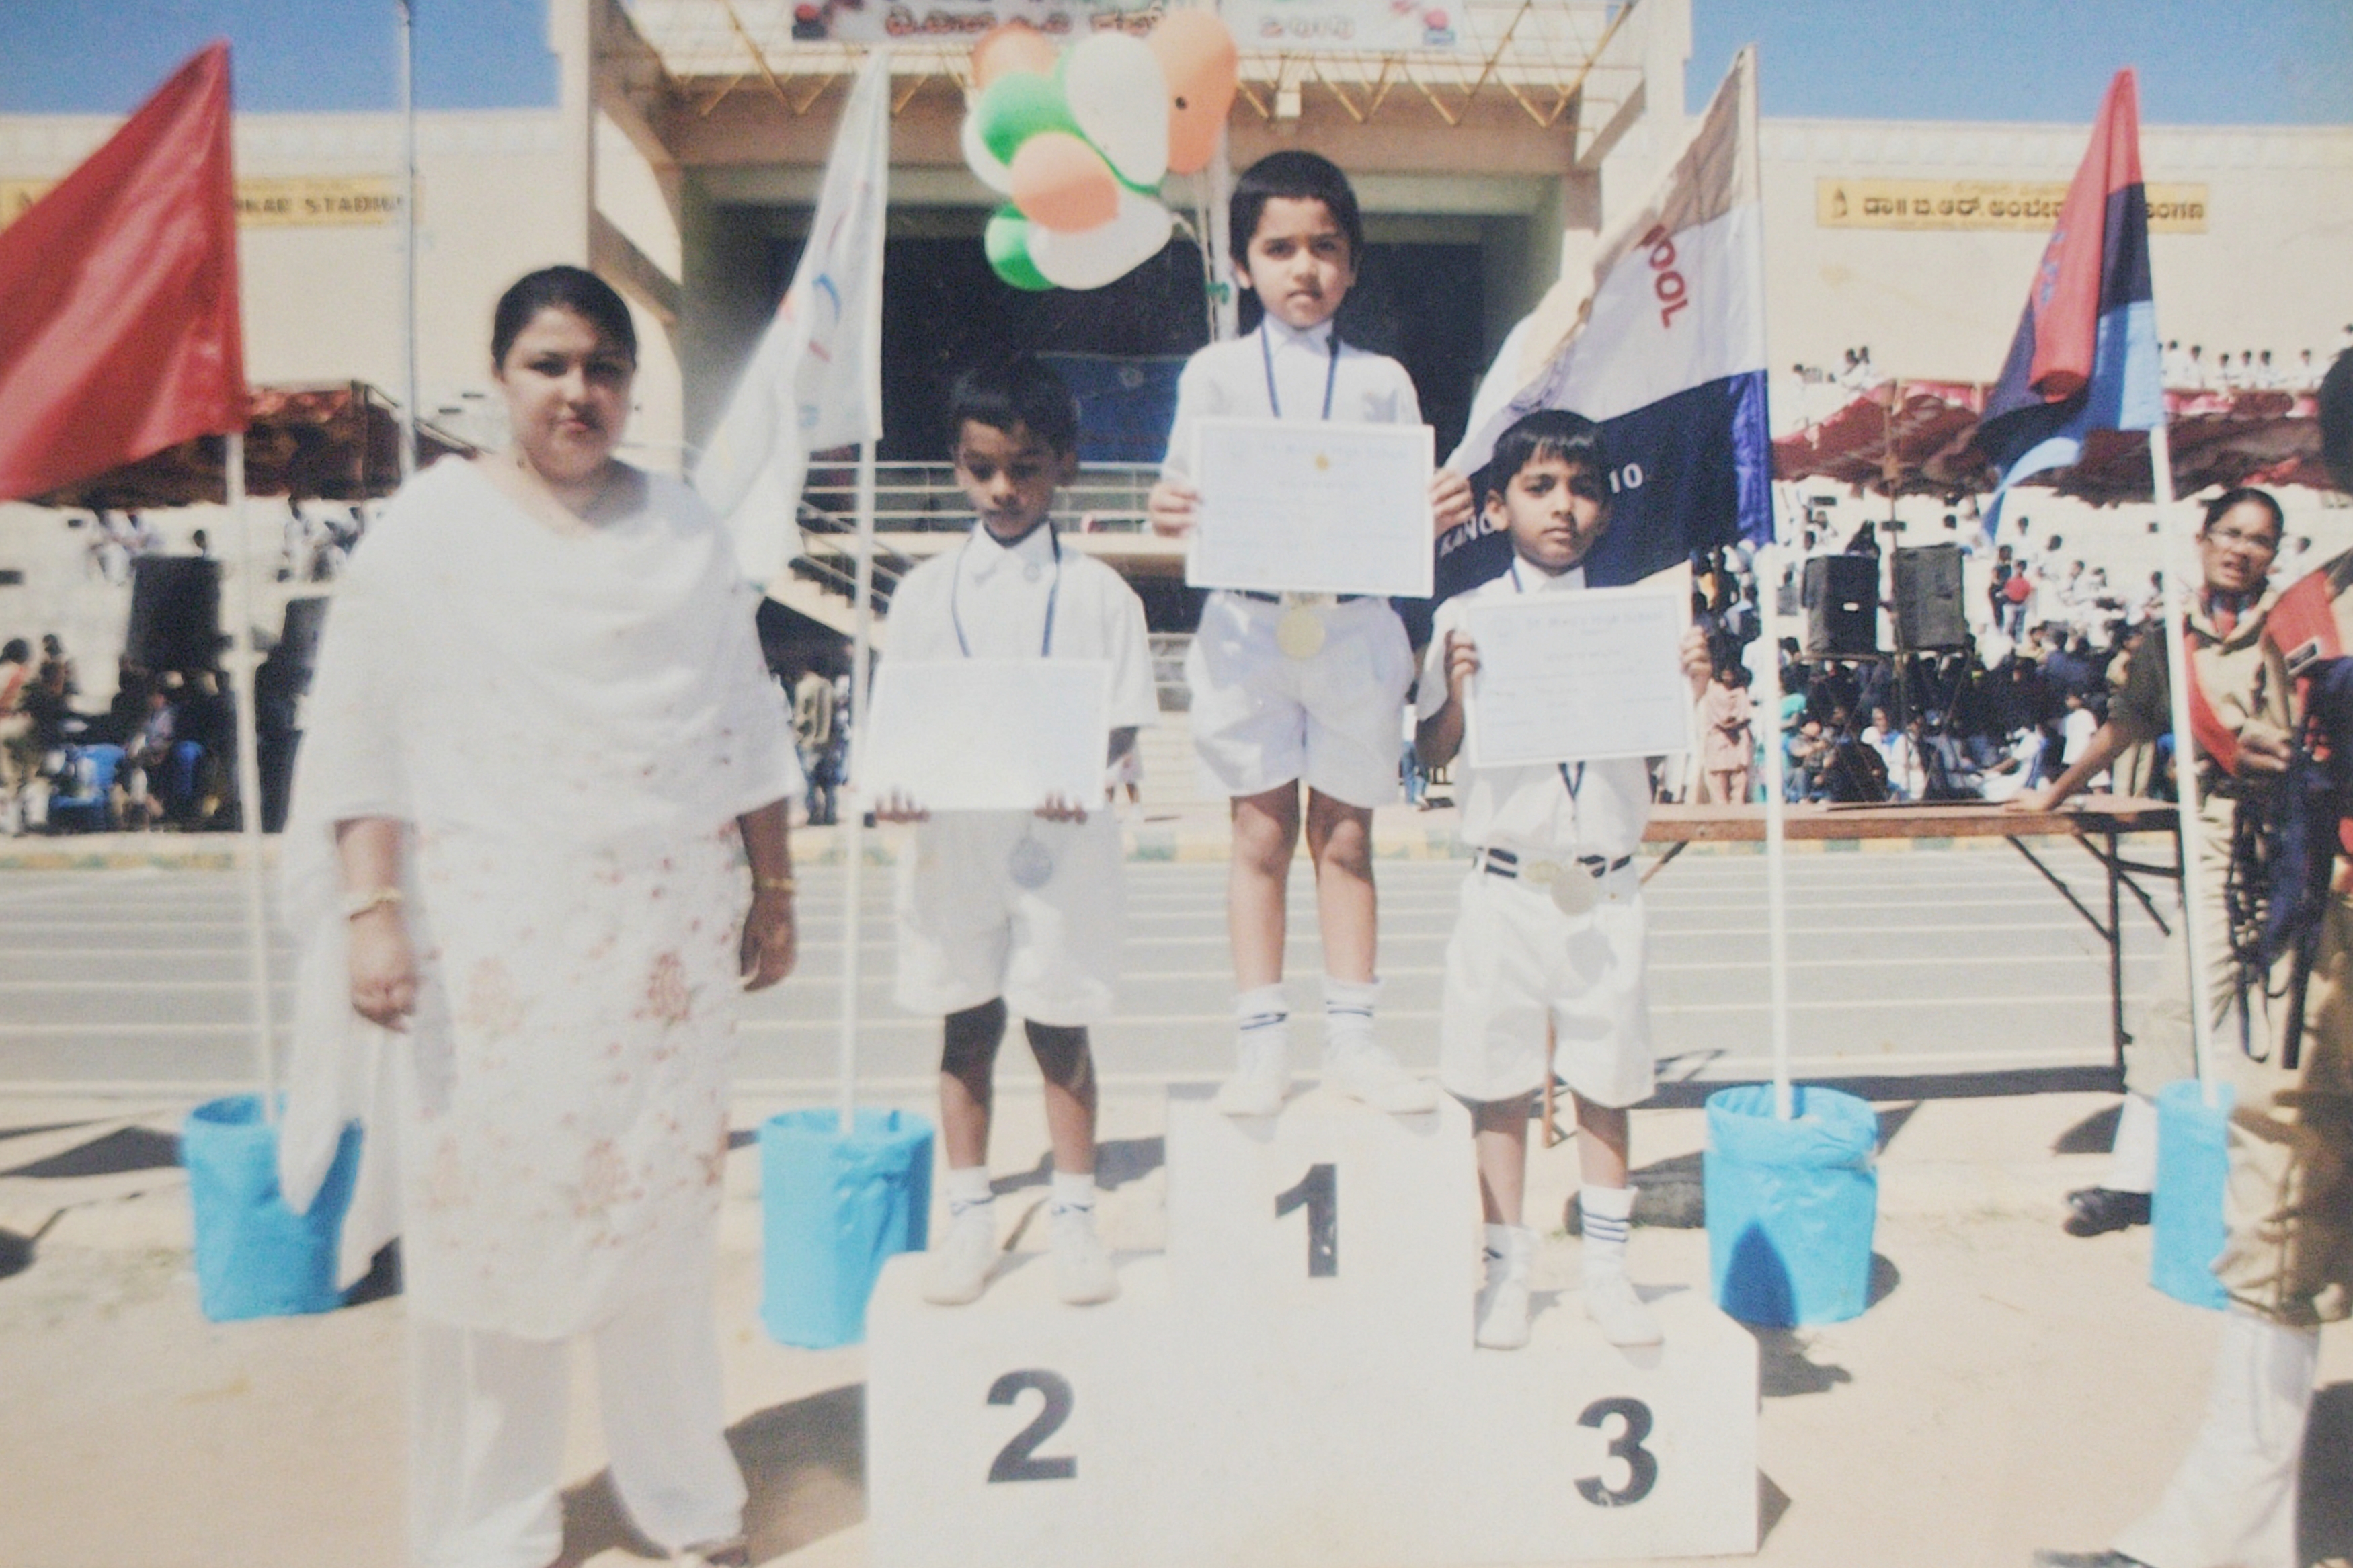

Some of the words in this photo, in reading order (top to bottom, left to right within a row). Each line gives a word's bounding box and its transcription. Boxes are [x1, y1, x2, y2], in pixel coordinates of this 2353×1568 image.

[1609, 462, 1644, 494] 10
[1275, 1163, 1337, 1277] 1
[986, 1368, 1078, 1483] 2
[1573, 1397, 1658, 1507] 3
